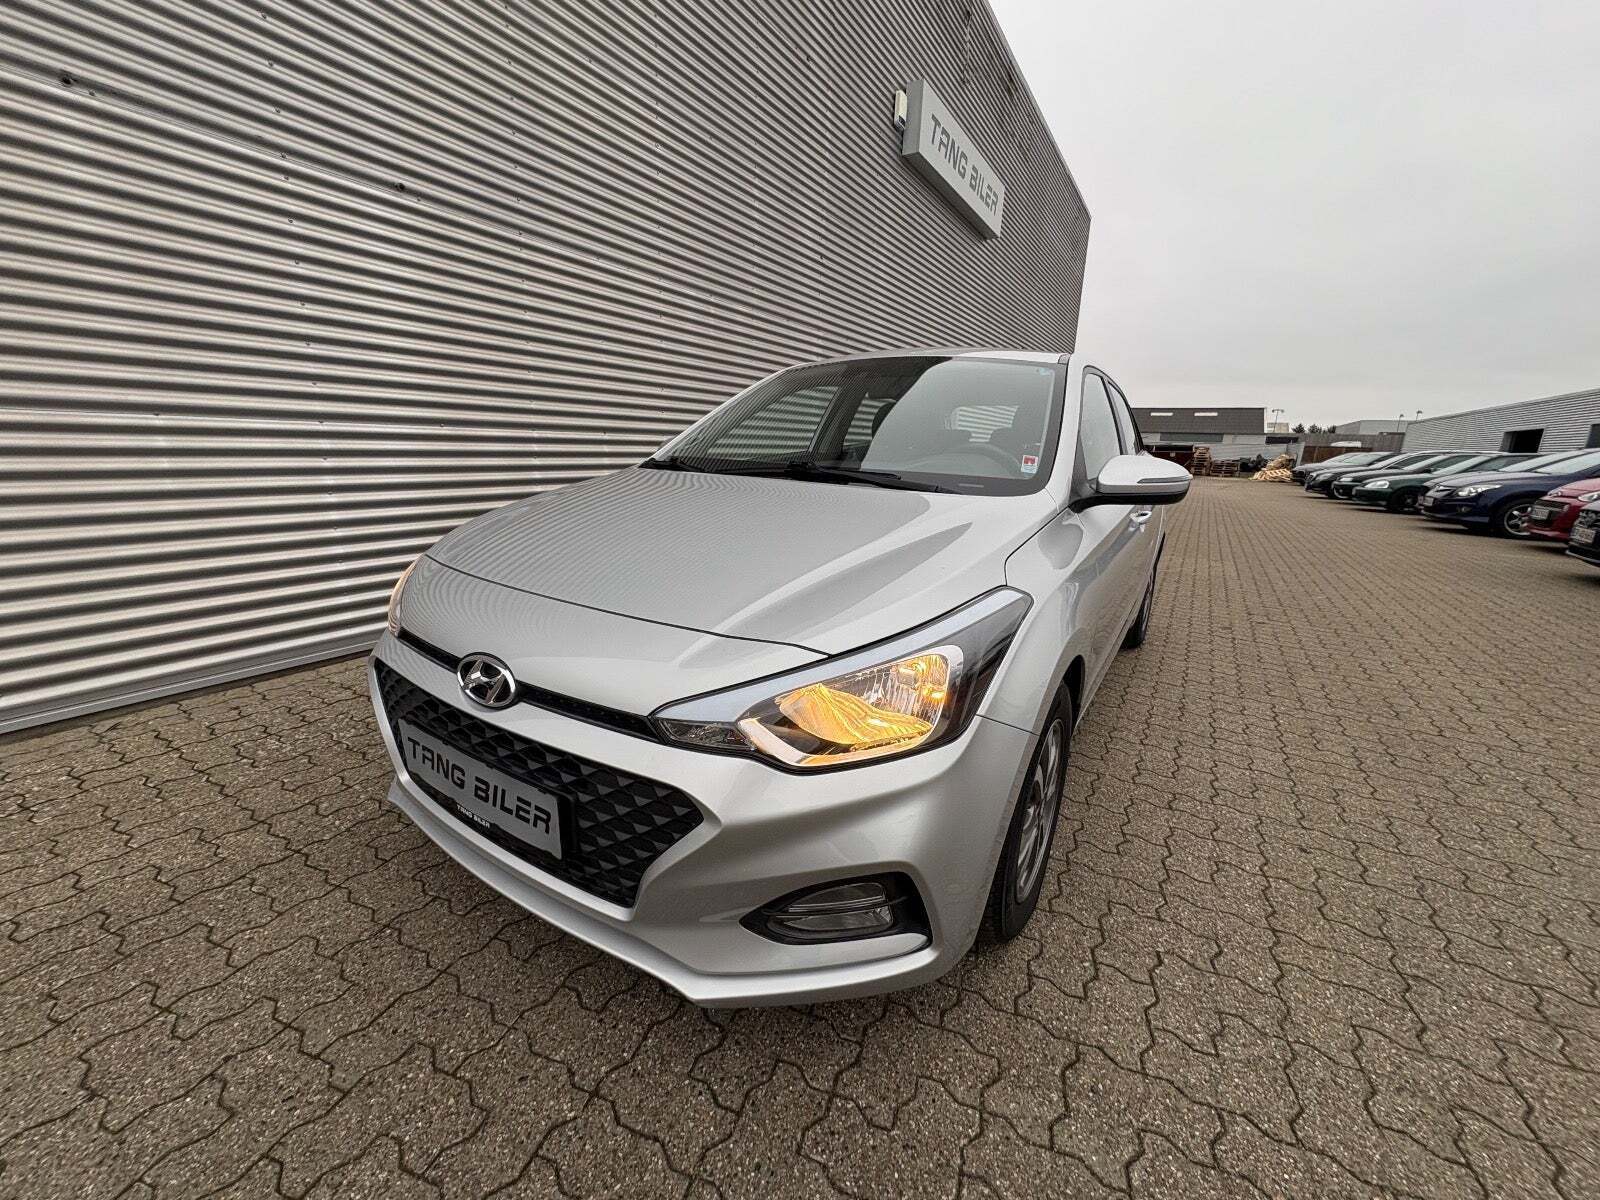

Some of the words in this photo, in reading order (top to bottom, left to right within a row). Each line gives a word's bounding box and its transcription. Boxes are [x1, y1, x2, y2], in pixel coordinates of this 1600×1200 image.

[931, 113, 969, 180] TANG
[969, 165, 999, 216] BILER
[407, 736, 466, 790] TANG
[473, 775, 552, 834] BILER
